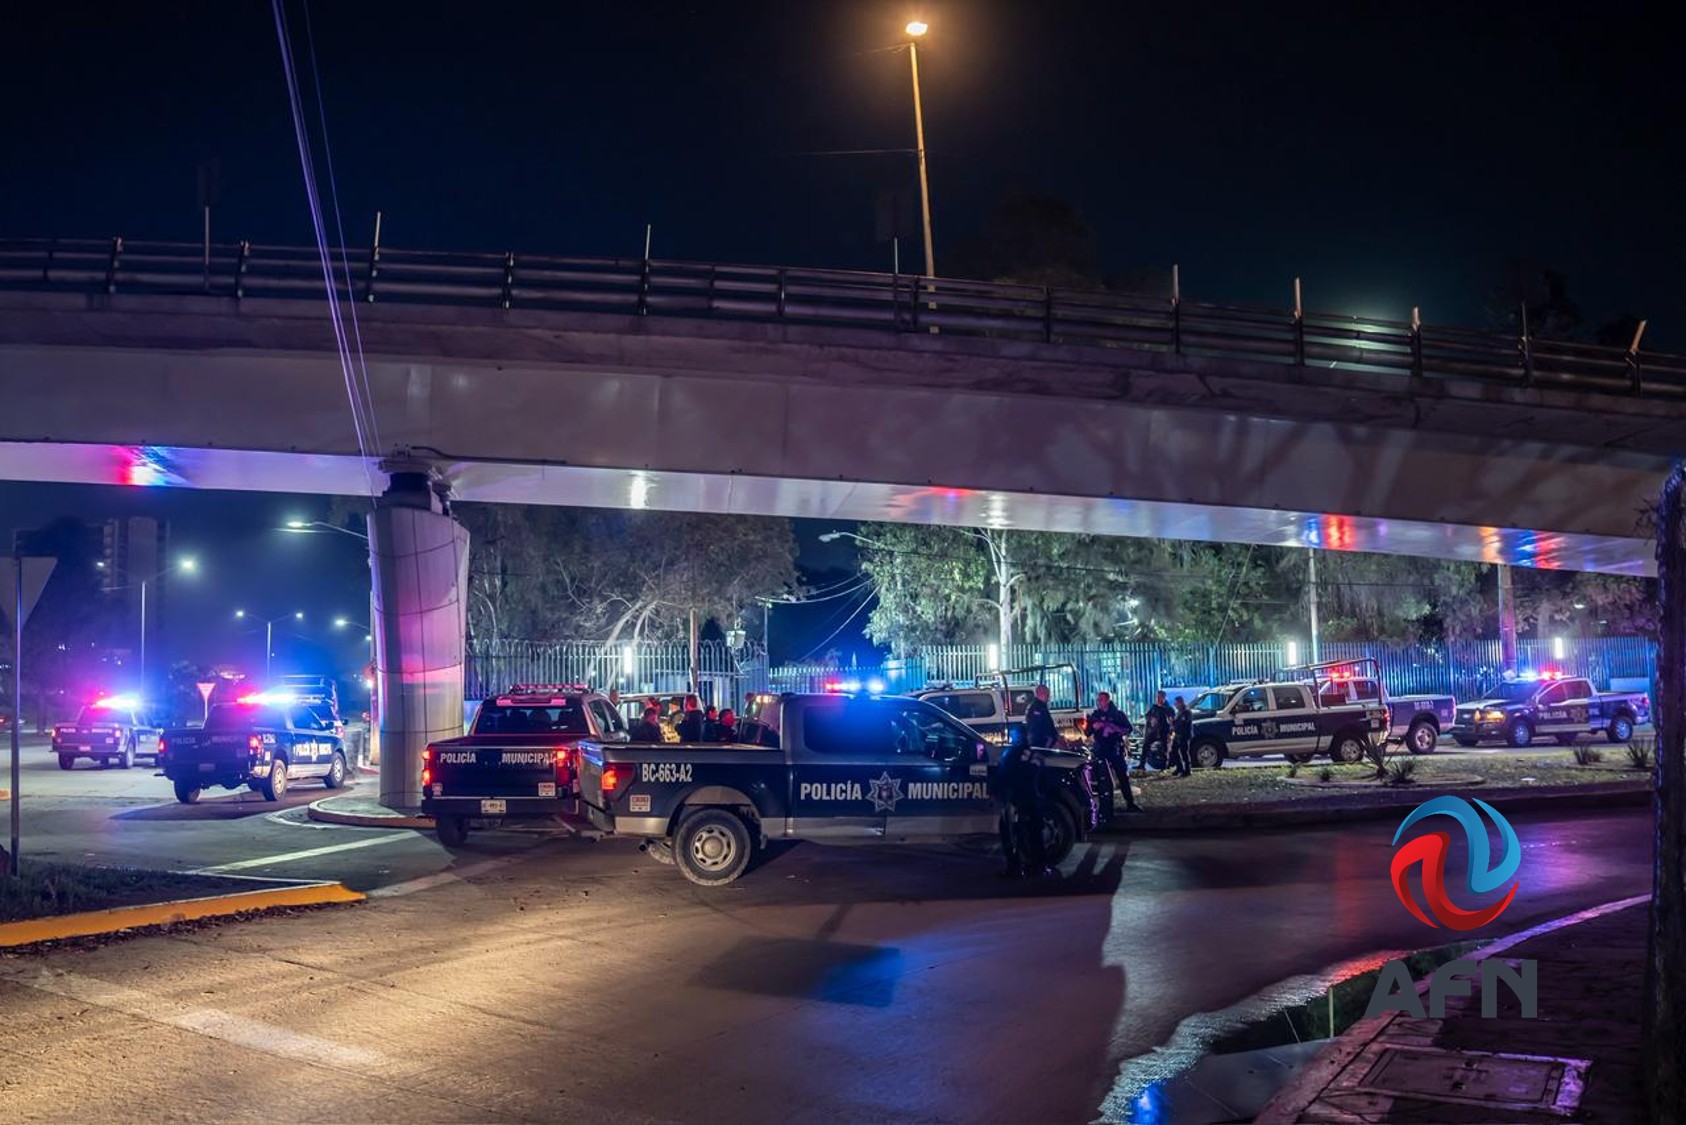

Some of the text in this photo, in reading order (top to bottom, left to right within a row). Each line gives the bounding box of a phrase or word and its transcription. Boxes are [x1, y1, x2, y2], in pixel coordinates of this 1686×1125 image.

[440, 751, 556, 764] POLICÍA MUNICIPAL
[642, 763, 692, 782] BC-663-A2
[800, 780, 989, 800] POLICÍA MUNICIPAL
